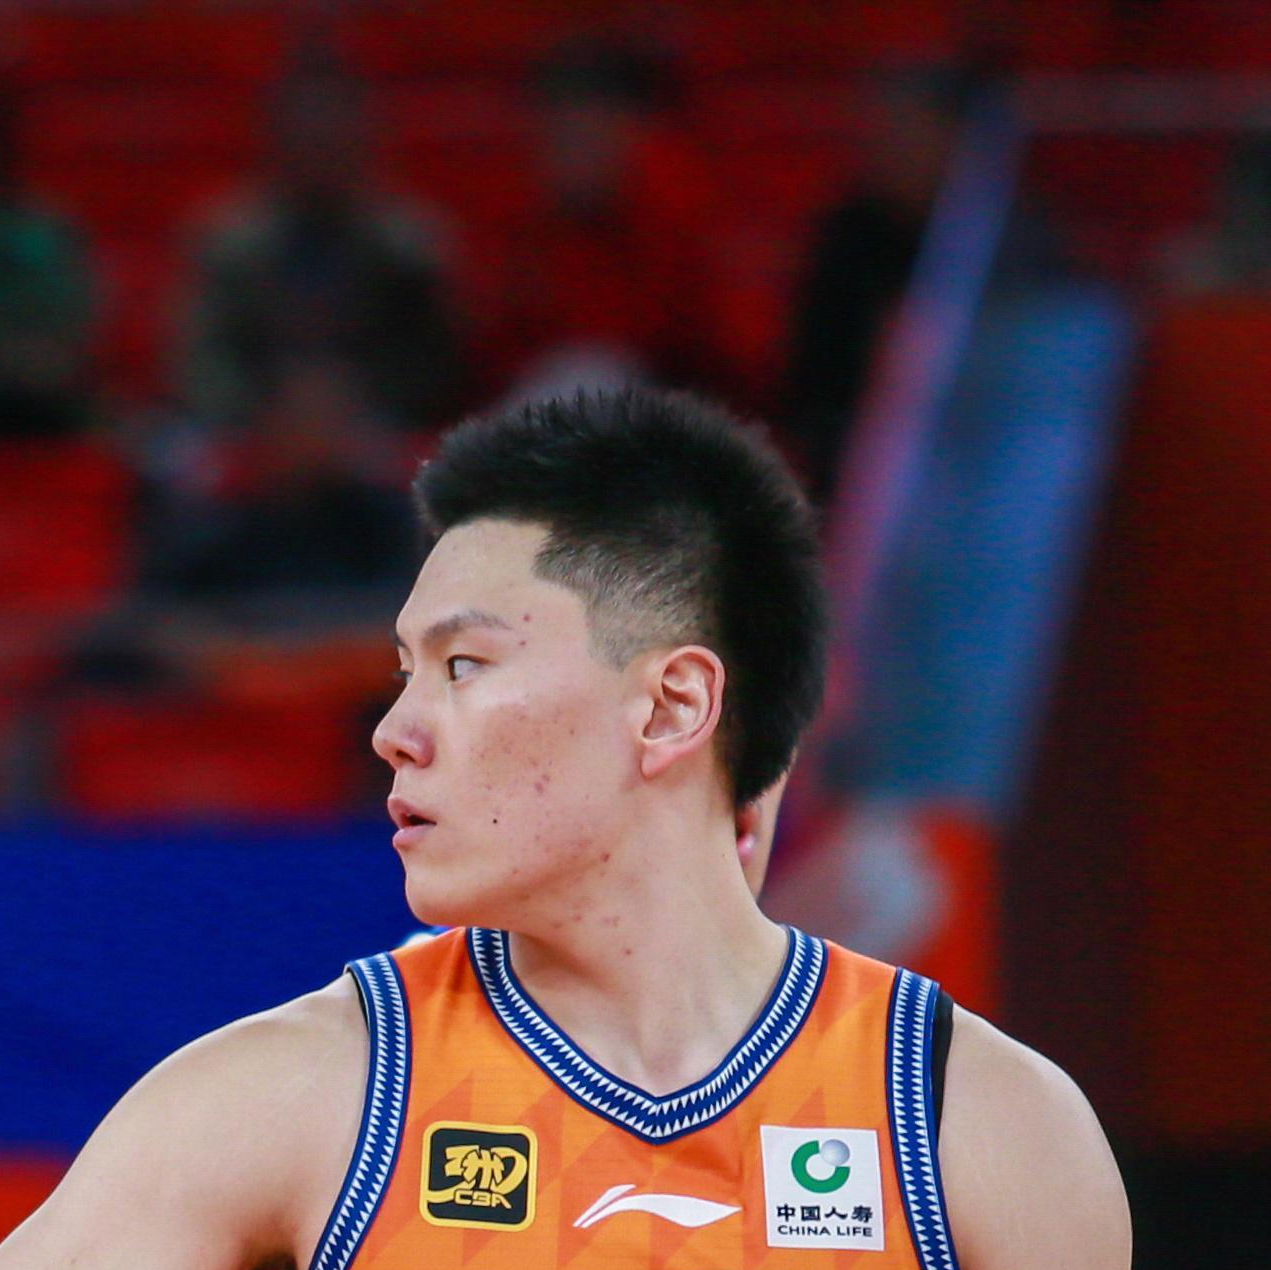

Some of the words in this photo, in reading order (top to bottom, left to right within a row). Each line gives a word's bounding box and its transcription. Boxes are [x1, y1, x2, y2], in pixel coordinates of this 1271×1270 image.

[454, 1189, 512, 1209] CBA
[776, 1203, 874, 1224] 中国人寿
[777, 1225, 832, 1236] CHINA
[836, 1226, 873, 1237] LIFE
